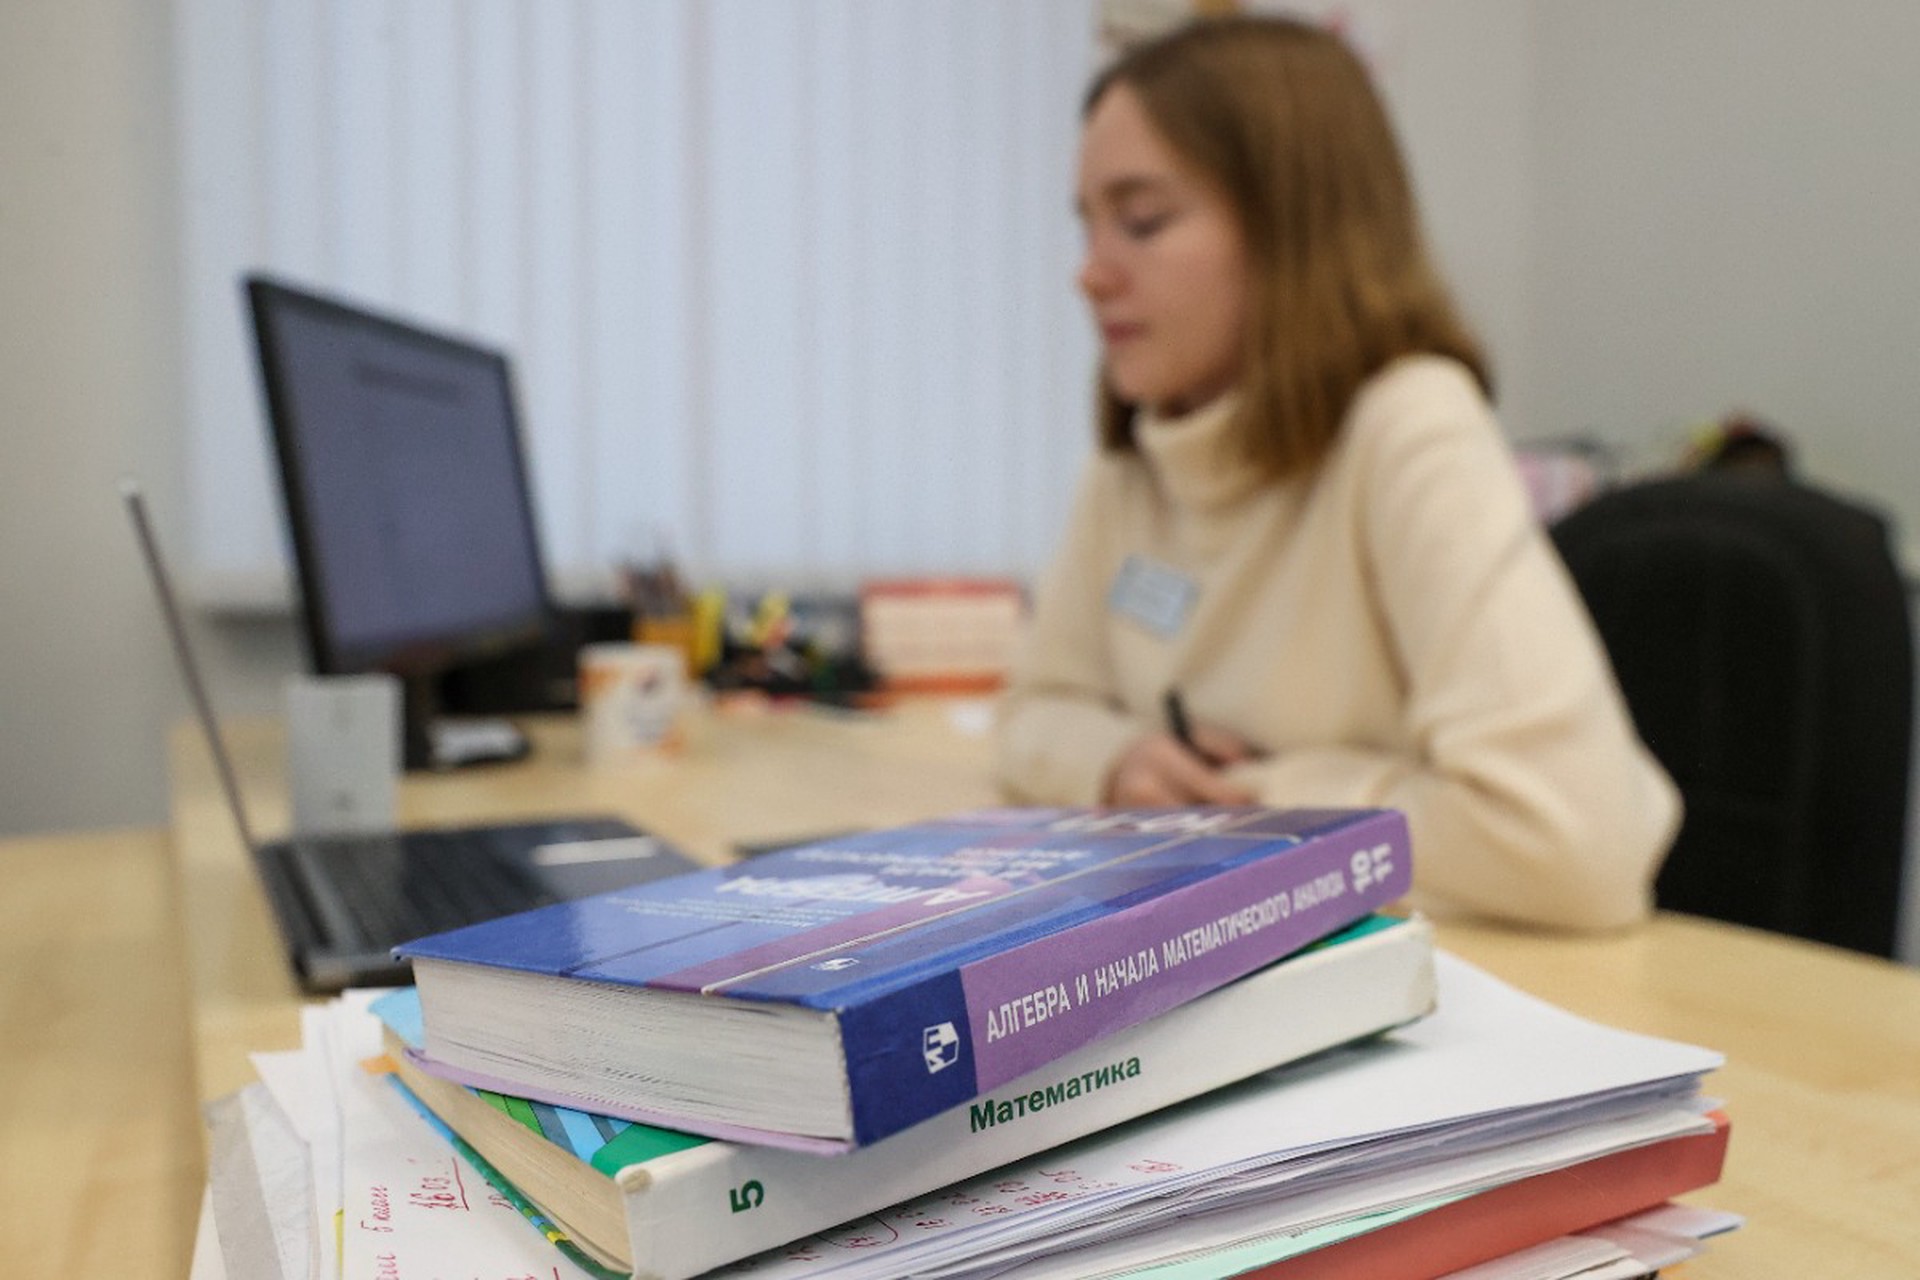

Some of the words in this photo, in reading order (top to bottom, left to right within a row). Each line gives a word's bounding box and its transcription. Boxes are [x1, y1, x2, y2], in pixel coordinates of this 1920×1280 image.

[1351, 850, 1373, 894] 10
[1371, 842, 1394, 882] 11
[986, 982, 1071, 1043] АЛГЕБРА
[1075, 974, 1090, 1006] И
[1094, 947, 1160, 997] НАЧАЛА
[1162, 891, 1291, 969] МАТЕМАТИЧЕСКОГО
[970, 1056, 1141, 1133] Математика
[729, 1179, 764, 1214] 5
